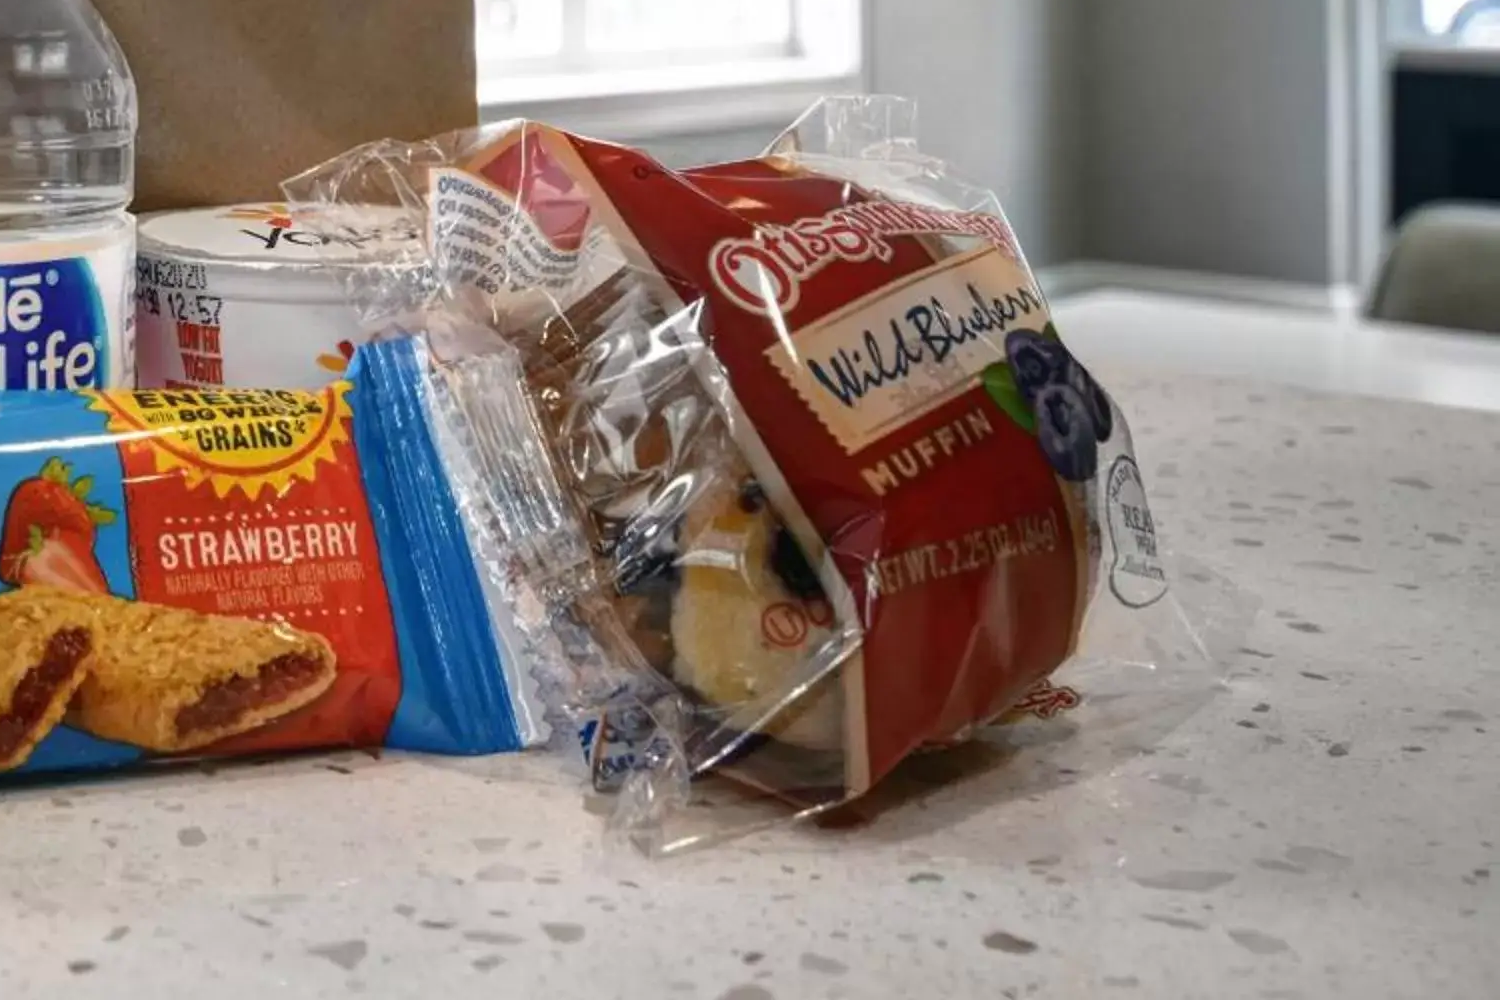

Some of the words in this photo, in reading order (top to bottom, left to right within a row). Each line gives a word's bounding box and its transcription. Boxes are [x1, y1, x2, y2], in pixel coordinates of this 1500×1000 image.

[806, 317, 923, 409] Wild
[196, 420, 293, 453] GRAINS
[861, 407, 994, 495] MUFFIN
[159, 521, 358, 570] STRAWBERRY
[165, 570, 233, 595] NATURALLY
